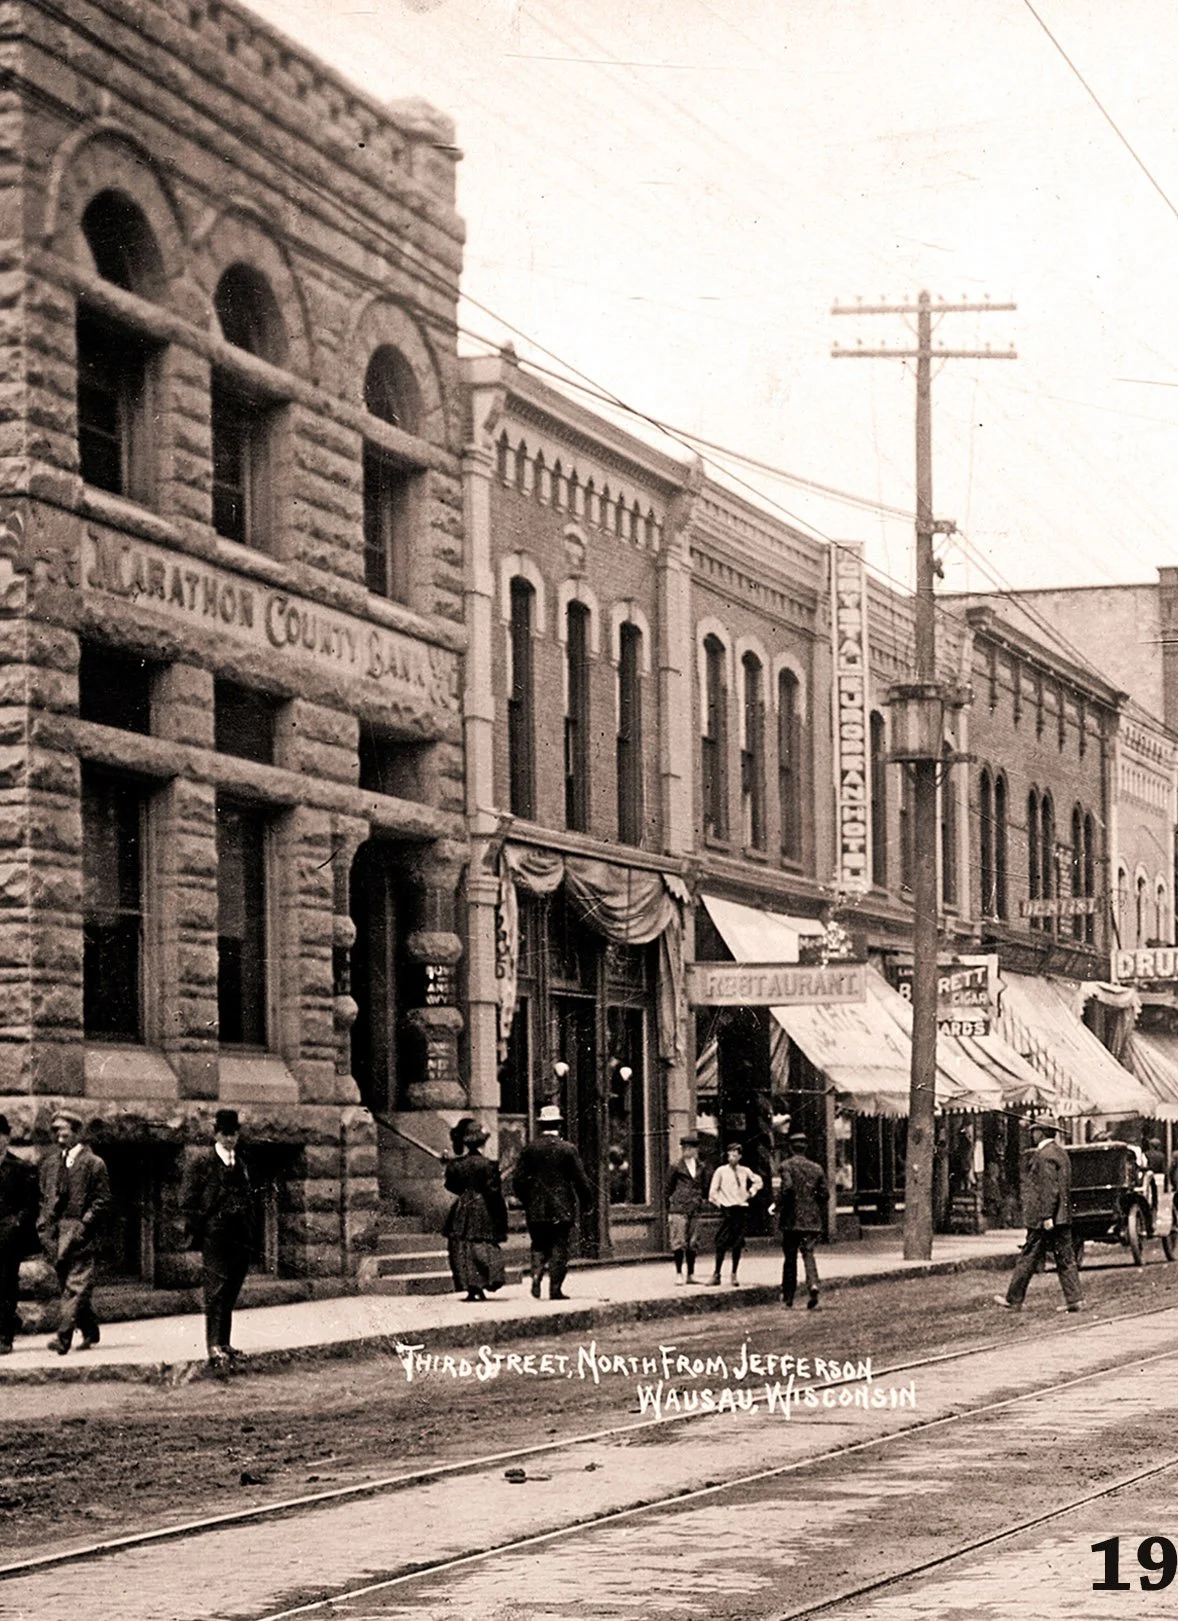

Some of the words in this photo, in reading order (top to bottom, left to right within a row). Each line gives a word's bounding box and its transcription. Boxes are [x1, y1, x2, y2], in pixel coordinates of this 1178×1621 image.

[264, 596, 358, 663] COUNTY
[839, 673, 867, 802] EUROPEAN
[841, 804, 868, 886] HOTEL
[938, 1021, 986, 1037] ARDS
